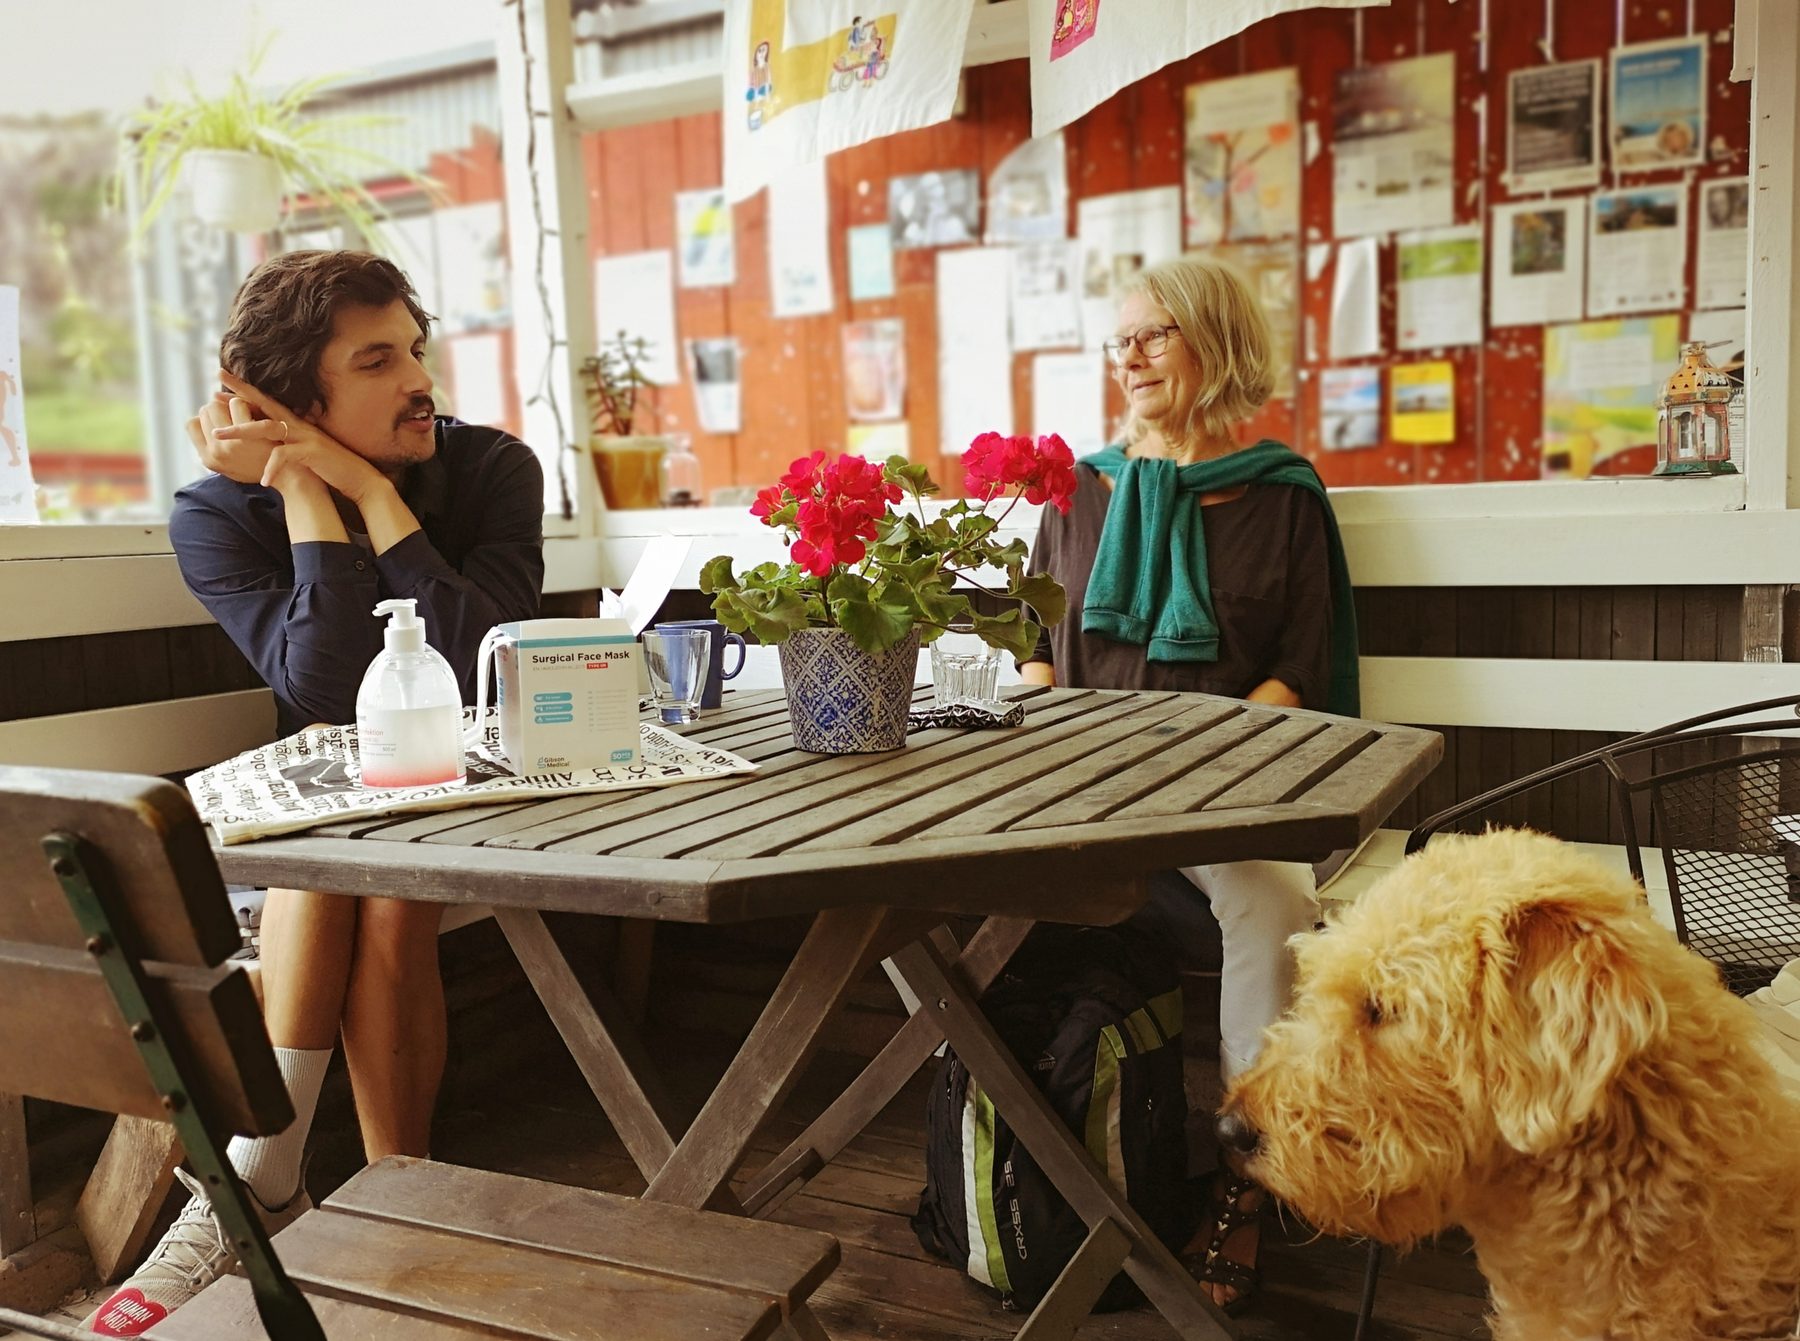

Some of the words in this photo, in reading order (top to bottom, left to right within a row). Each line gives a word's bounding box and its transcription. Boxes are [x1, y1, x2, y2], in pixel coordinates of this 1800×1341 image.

[532, 653, 575, 664] Surgical
[577, 652, 602, 661] Face
[604, 650, 630, 660] Mask
[546, 760, 570, 768] Medical
[612, 752, 621, 760] 50
[1004, 1160, 1015, 1187] 25
[101, 1307, 132, 1333] MADE
[113, 1297, 154, 1323] HUMAN
